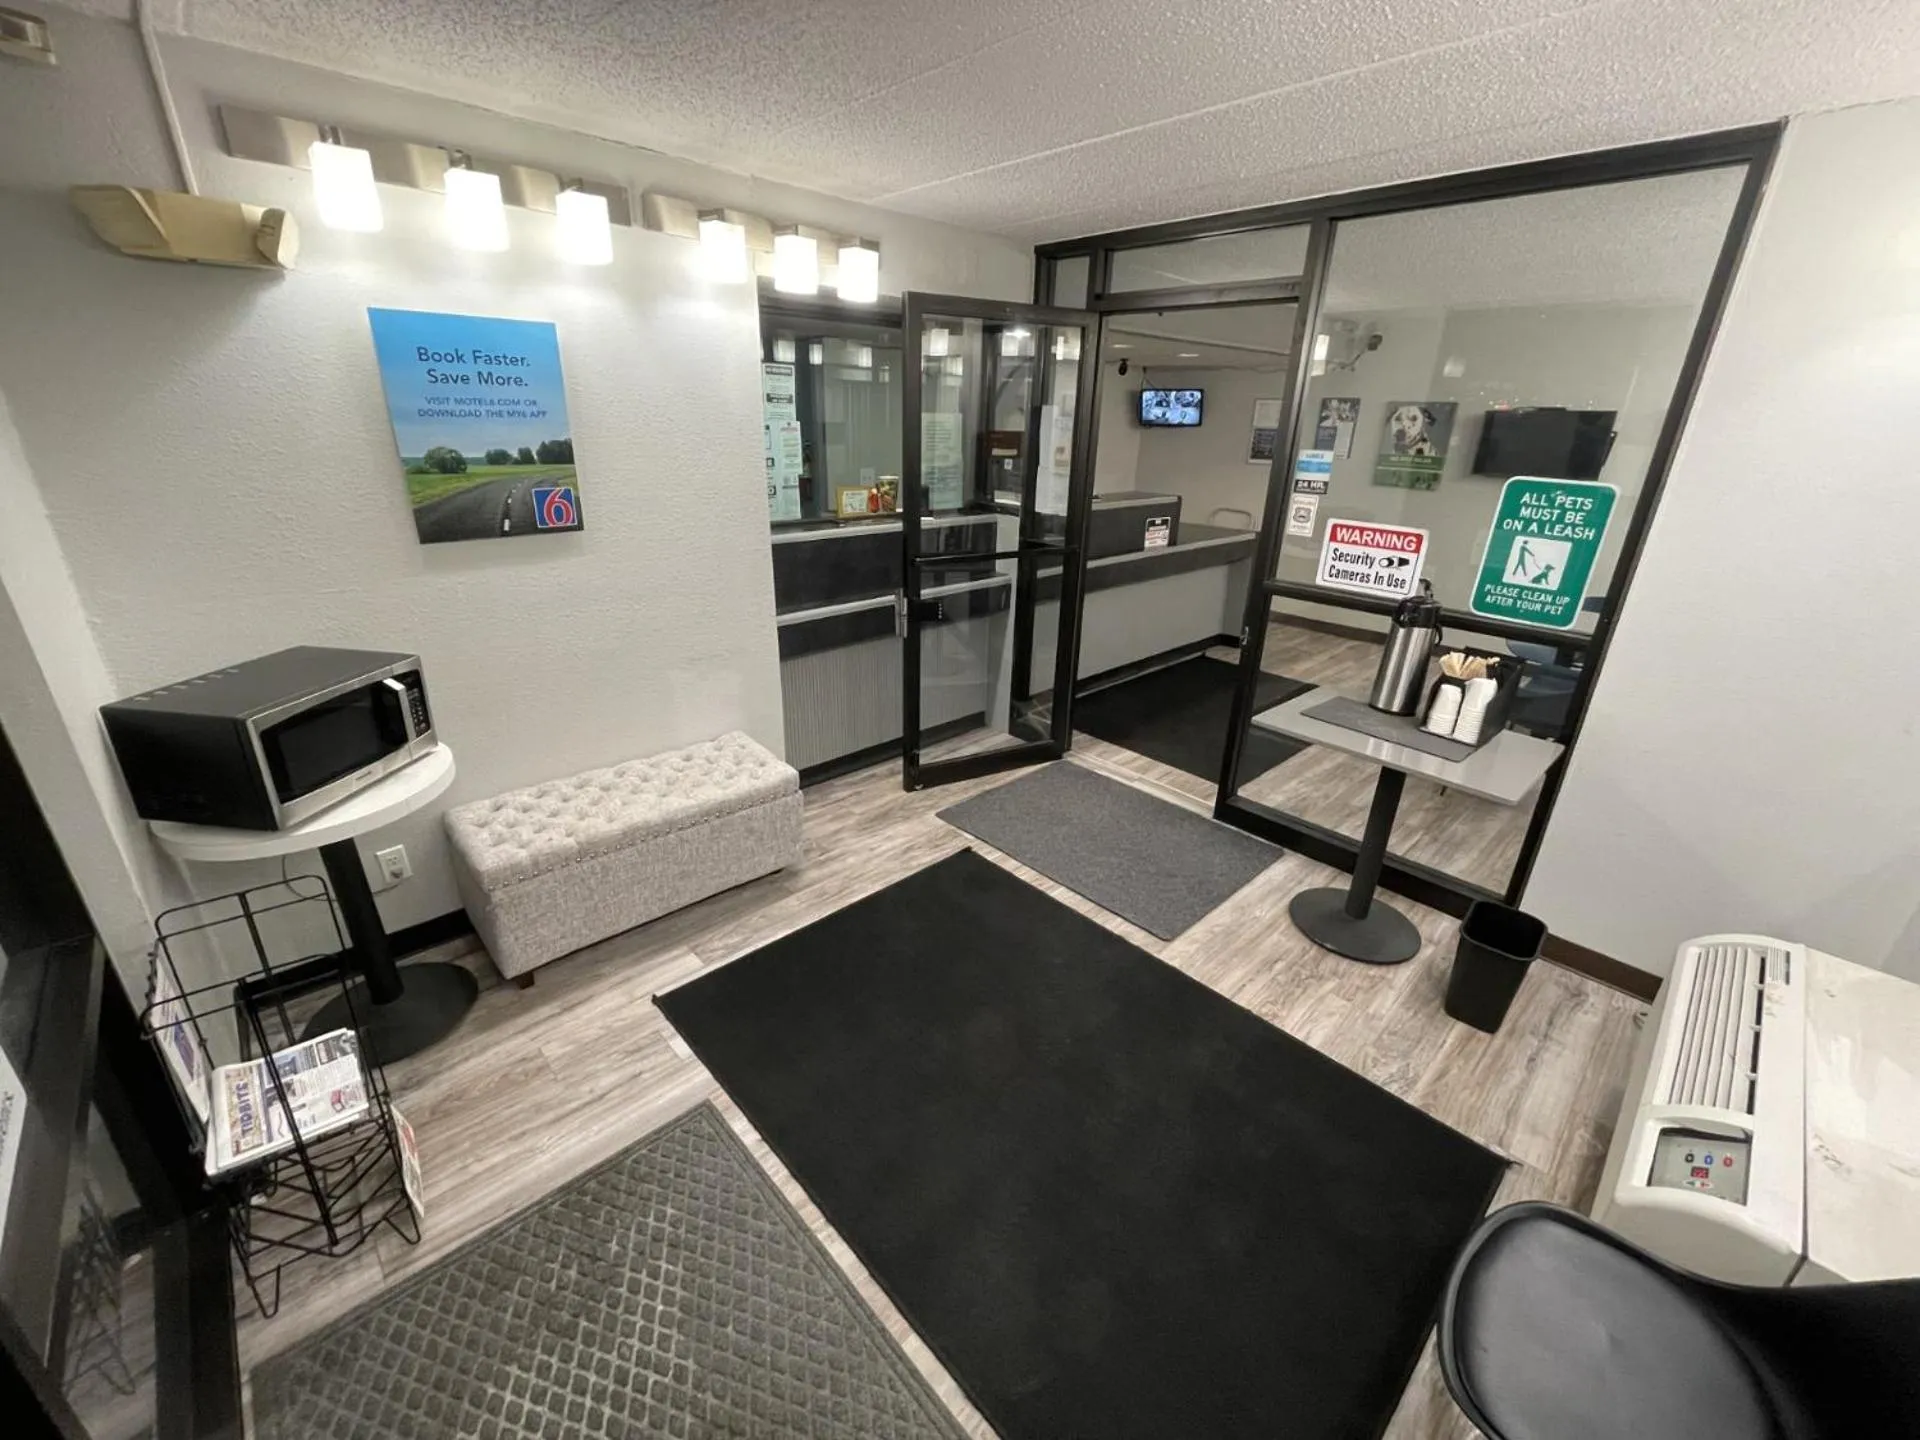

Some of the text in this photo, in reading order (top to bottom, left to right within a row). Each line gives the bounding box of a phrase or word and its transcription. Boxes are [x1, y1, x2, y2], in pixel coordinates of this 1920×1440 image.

[416, 345, 531, 367] Book Faster.
[426, 368, 528, 387] Save More.
[424, 396, 450, 406] VISIT
[523, 399, 537, 407] OR
[417, 408, 482, 418] DOWNLOAD
[485, 409, 504, 418] THE
[529, 410, 548, 419] APP
[544, 487, 572, 527] 6
[1520, 491, 1594, 510] ALL PETS
[1520, 506, 1587, 525] MUST BE
[1336, 527, 1417, 551] WARNING
[1503, 518, 1596, 540] ON A LEASH
[1332, 547, 1376, 569] Security
[1329, 564, 1407, 589] Cameras In Use
[1484, 584, 1571, 606] PLEASE CLEAN UP
[1484, 594, 1564, 616] AFTER YOUR PET
[236, 1081, 254, 1138] TIDBITS
